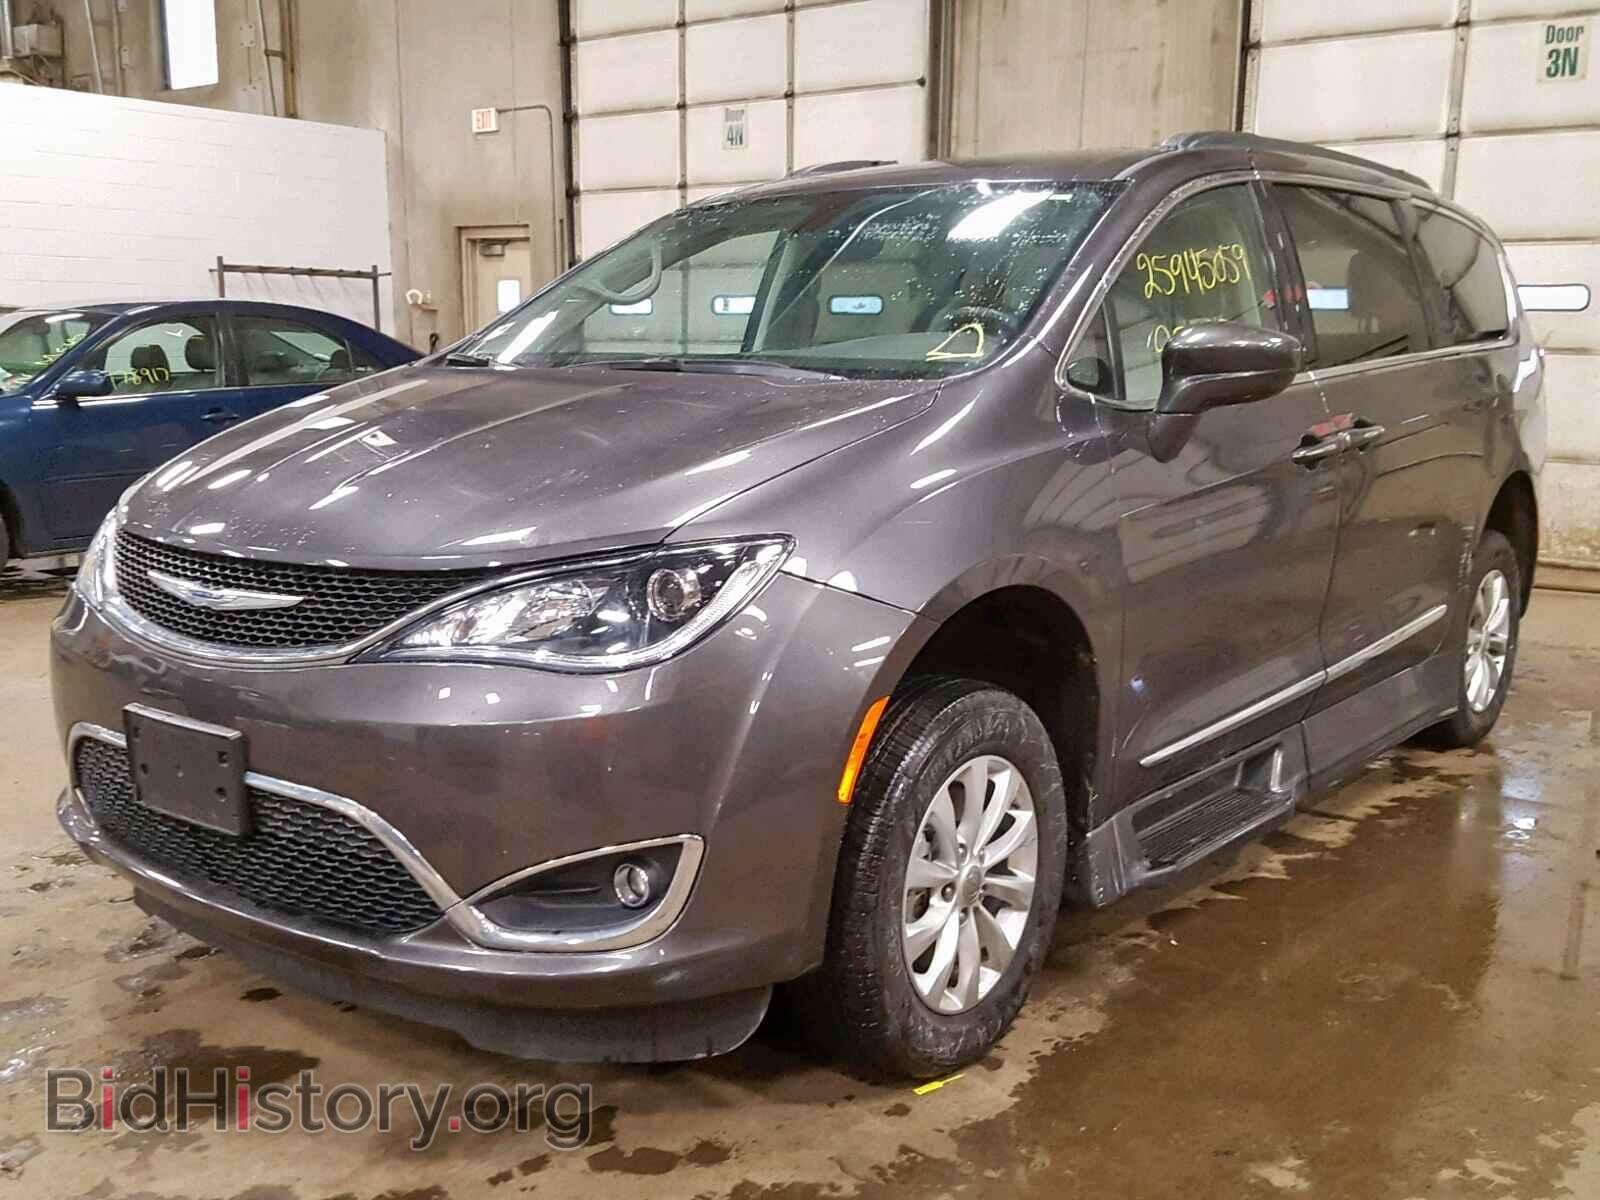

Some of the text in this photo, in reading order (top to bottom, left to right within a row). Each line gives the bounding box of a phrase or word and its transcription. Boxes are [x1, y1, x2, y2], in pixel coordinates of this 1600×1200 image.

[1545, 25, 1584, 44] Door
[1546, 47, 1579, 78] 3N
[727, 124, 744, 146] 4N
[1136, 243, 1254, 299] 25945059
